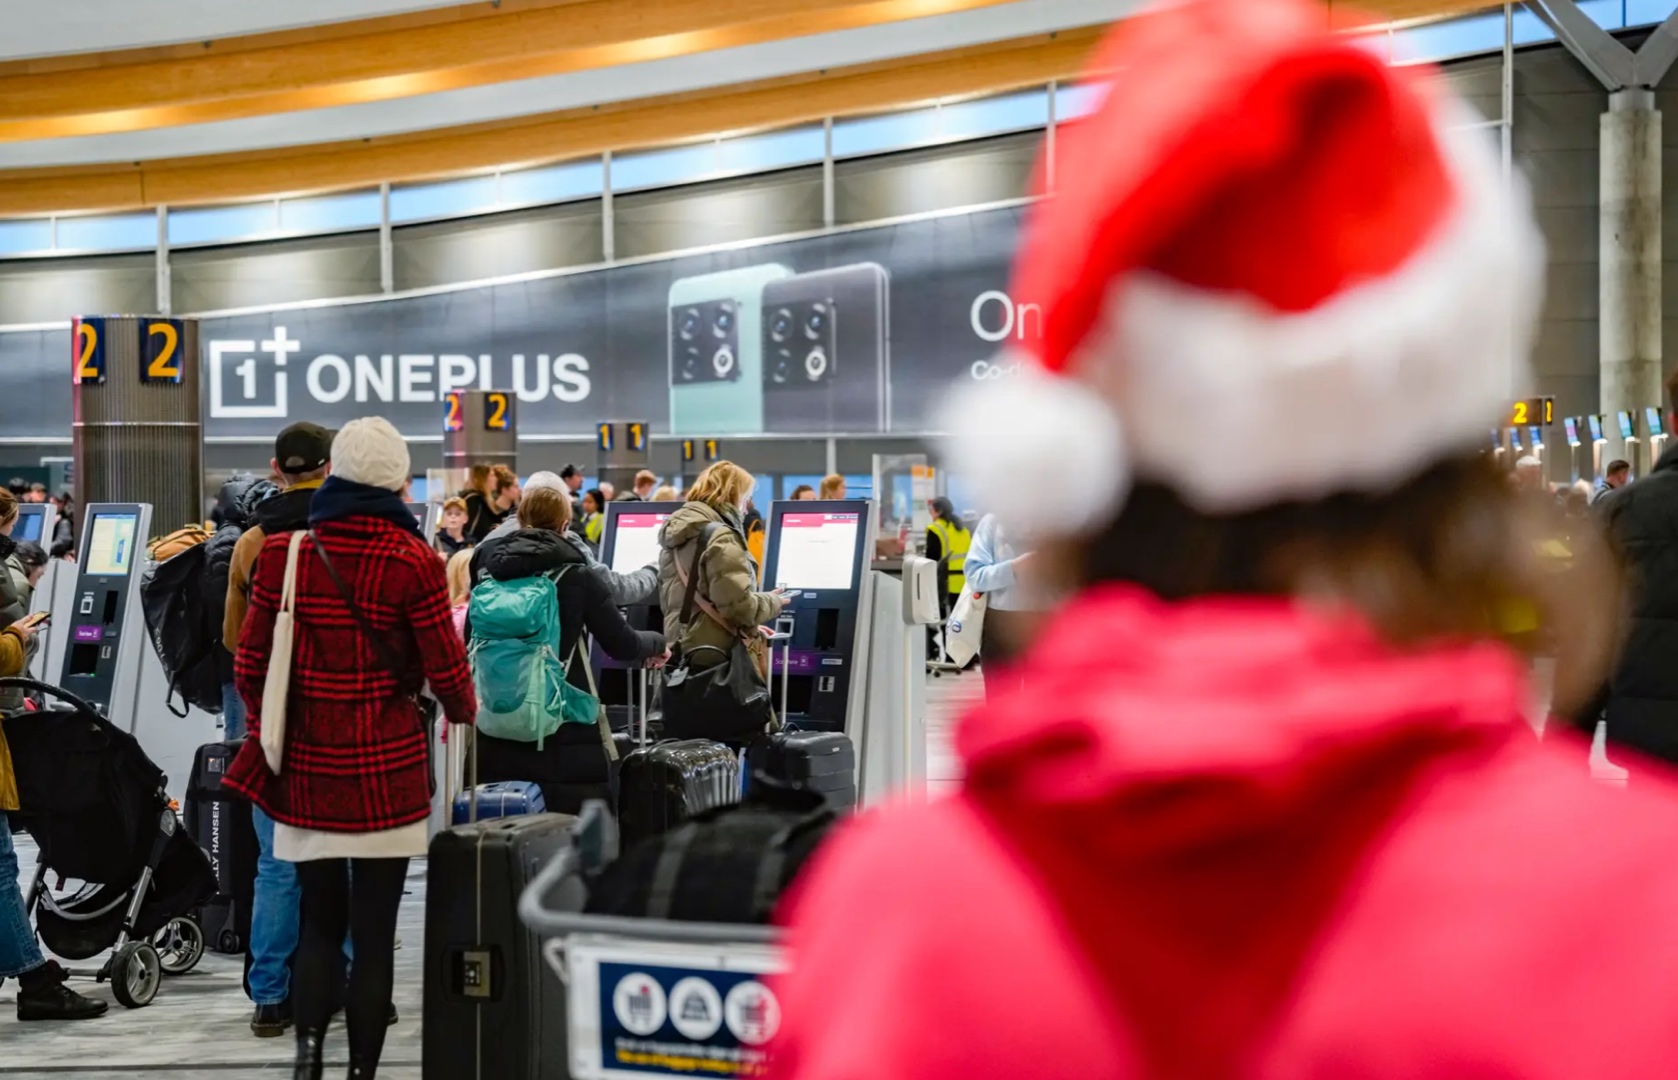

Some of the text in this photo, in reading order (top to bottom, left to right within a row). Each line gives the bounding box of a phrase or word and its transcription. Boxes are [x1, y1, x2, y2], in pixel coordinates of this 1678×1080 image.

[970, 290, 1042, 341] On
[77, 323, 98, 378] 2
[147, 323, 179, 378] 2
[306, 353, 591, 403] ONEPLUS
[446, 394, 461, 427] 2
[488, 394, 506, 427] 2
[1513, 402, 1528, 424] 2
[600, 424, 609, 448] 1
[630, 423, 641, 448] 1
[683, 440, 692, 459] 1
[707, 440, 717, 459] 1
[212, 801, 220, 853] HANSEN
